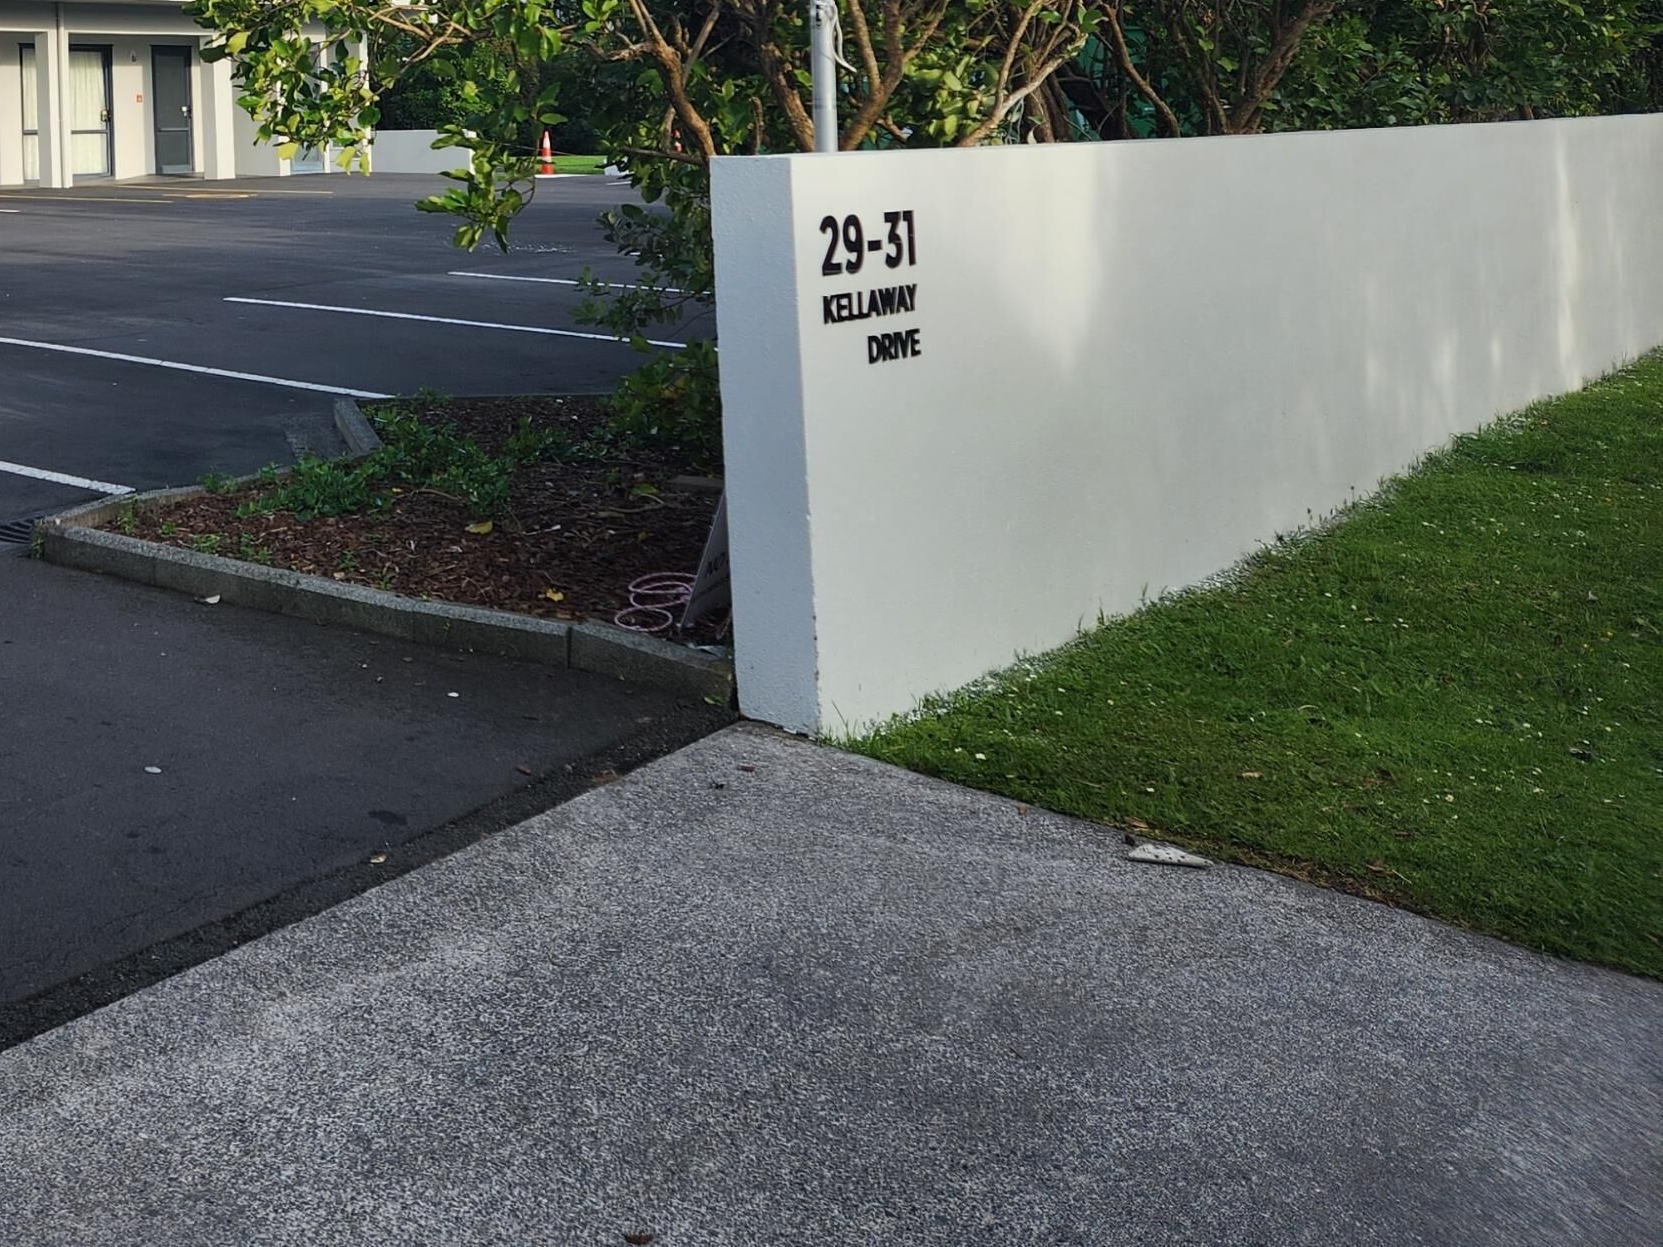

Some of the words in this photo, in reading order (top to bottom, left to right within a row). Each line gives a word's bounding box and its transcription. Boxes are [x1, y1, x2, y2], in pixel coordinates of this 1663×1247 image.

[819, 210, 916, 276] 29-31
[822, 283, 917, 324] KELLAWAY
[867, 328, 922, 364] DRIVE
